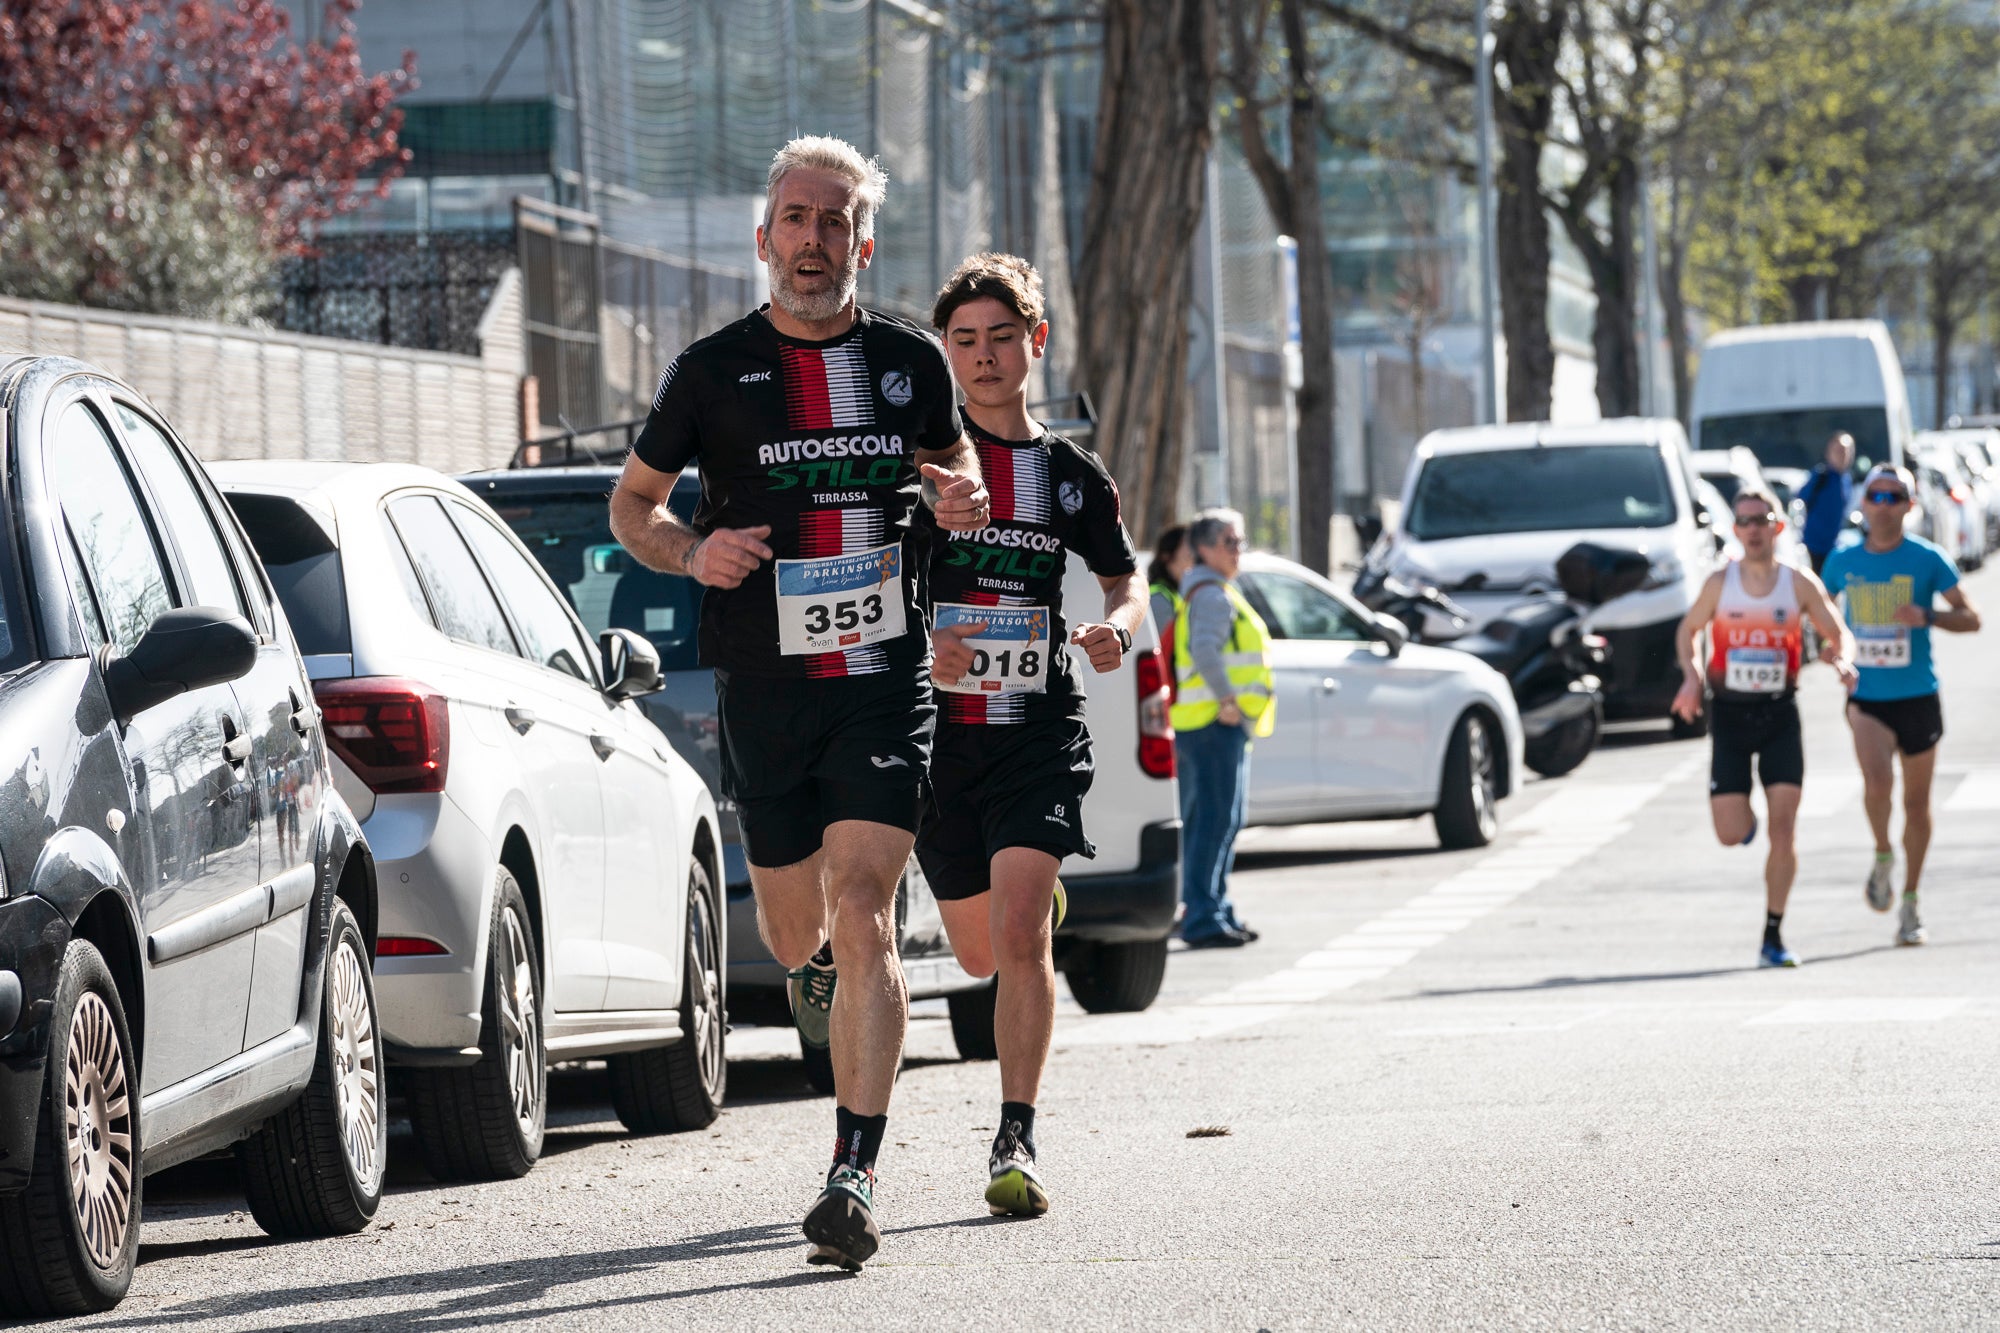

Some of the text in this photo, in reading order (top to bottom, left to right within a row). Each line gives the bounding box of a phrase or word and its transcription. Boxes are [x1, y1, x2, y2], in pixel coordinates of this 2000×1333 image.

[739, 371, 771, 383] 42K
[758, 434, 904, 465] AUTOESCOLA
[766, 458, 902, 491] STILO
[812, 491, 869, 504] TERRASSA
[803, 558, 881, 579] PARKINSON
[944, 541, 1056, 579] STILO
[977, 577, 1025, 592] TERRASSA
[804, 593, 883, 634] 353
[957, 614, 1030, 626] PARKINSON
[811, 638, 834, 648] avan
[967, 648, 1040, 678] 018
